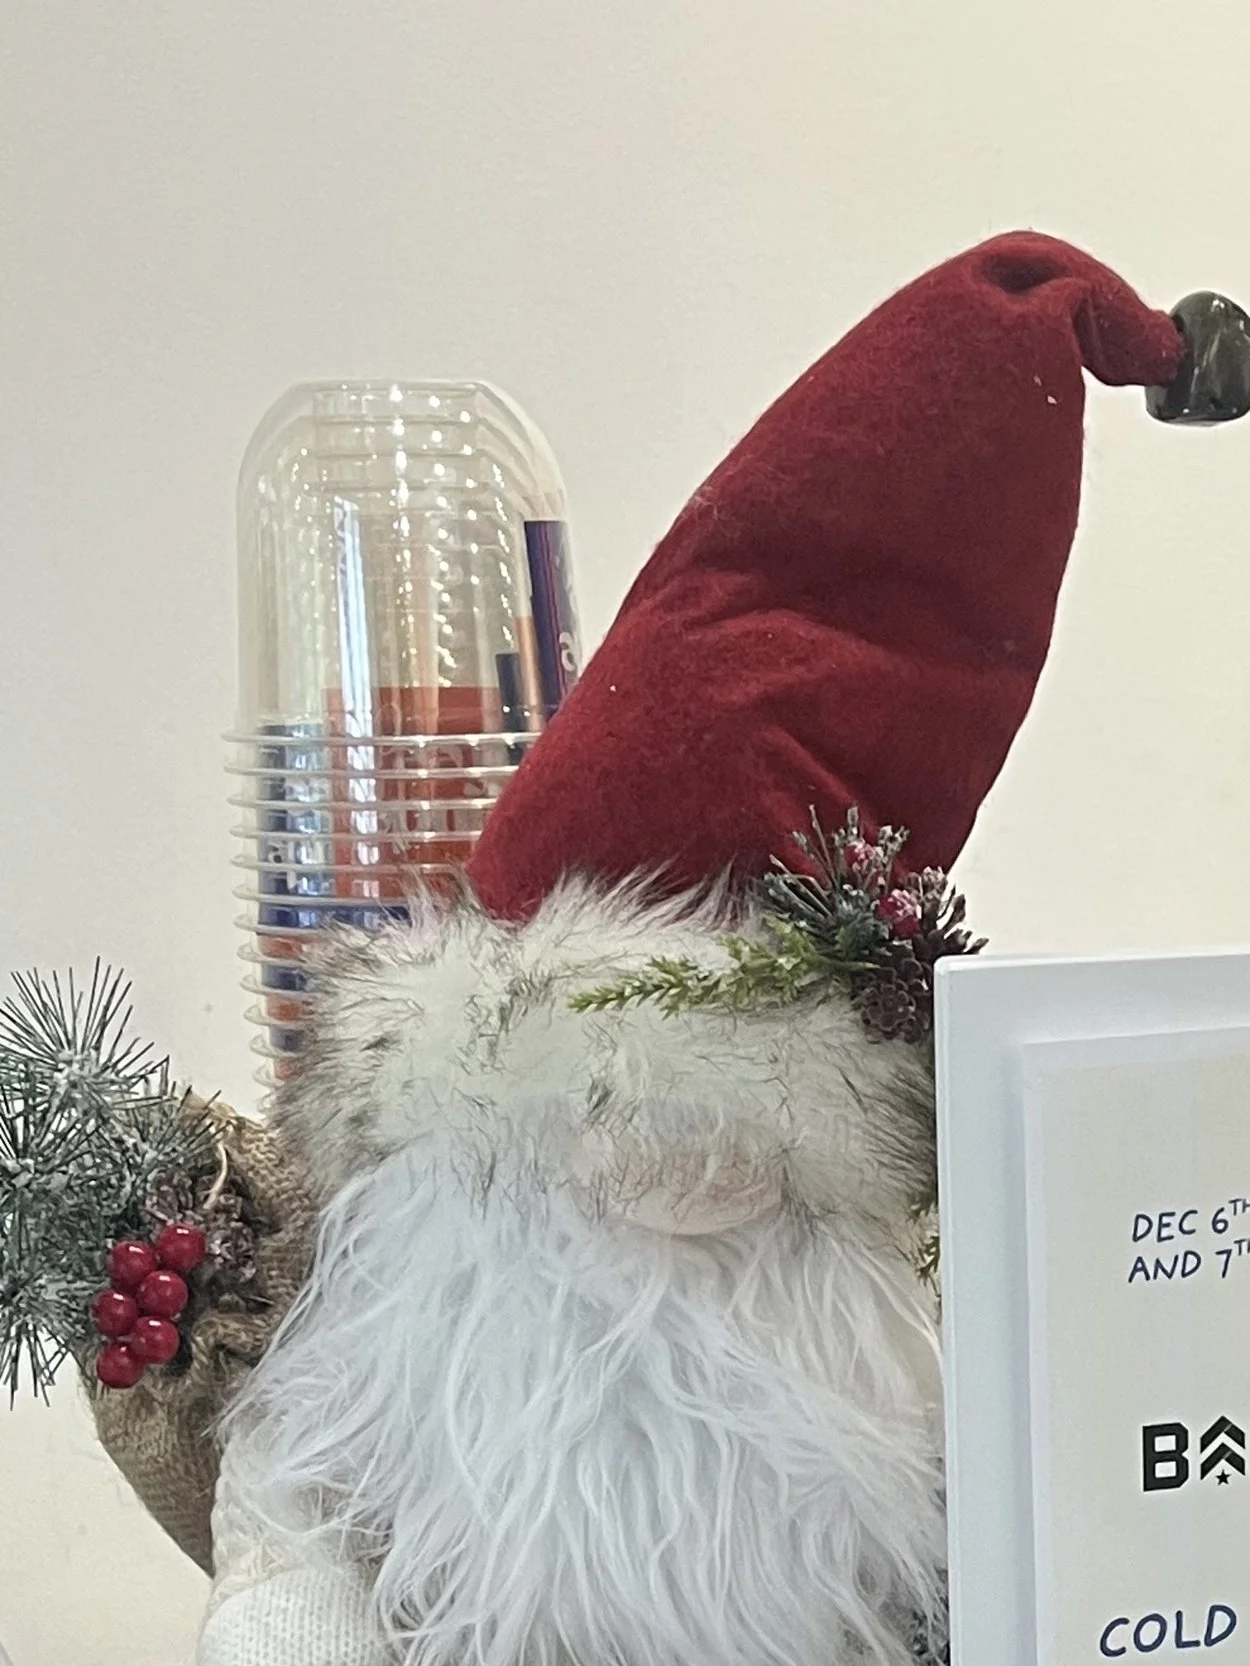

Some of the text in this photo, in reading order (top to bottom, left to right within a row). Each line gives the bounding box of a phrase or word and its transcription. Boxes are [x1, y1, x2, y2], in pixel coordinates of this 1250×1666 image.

[1131, 1208, 1199, 1244] DEC
[1127, 1249, 1202, 1284] AND
[1099, 1604, 1238, 1658] COLD
